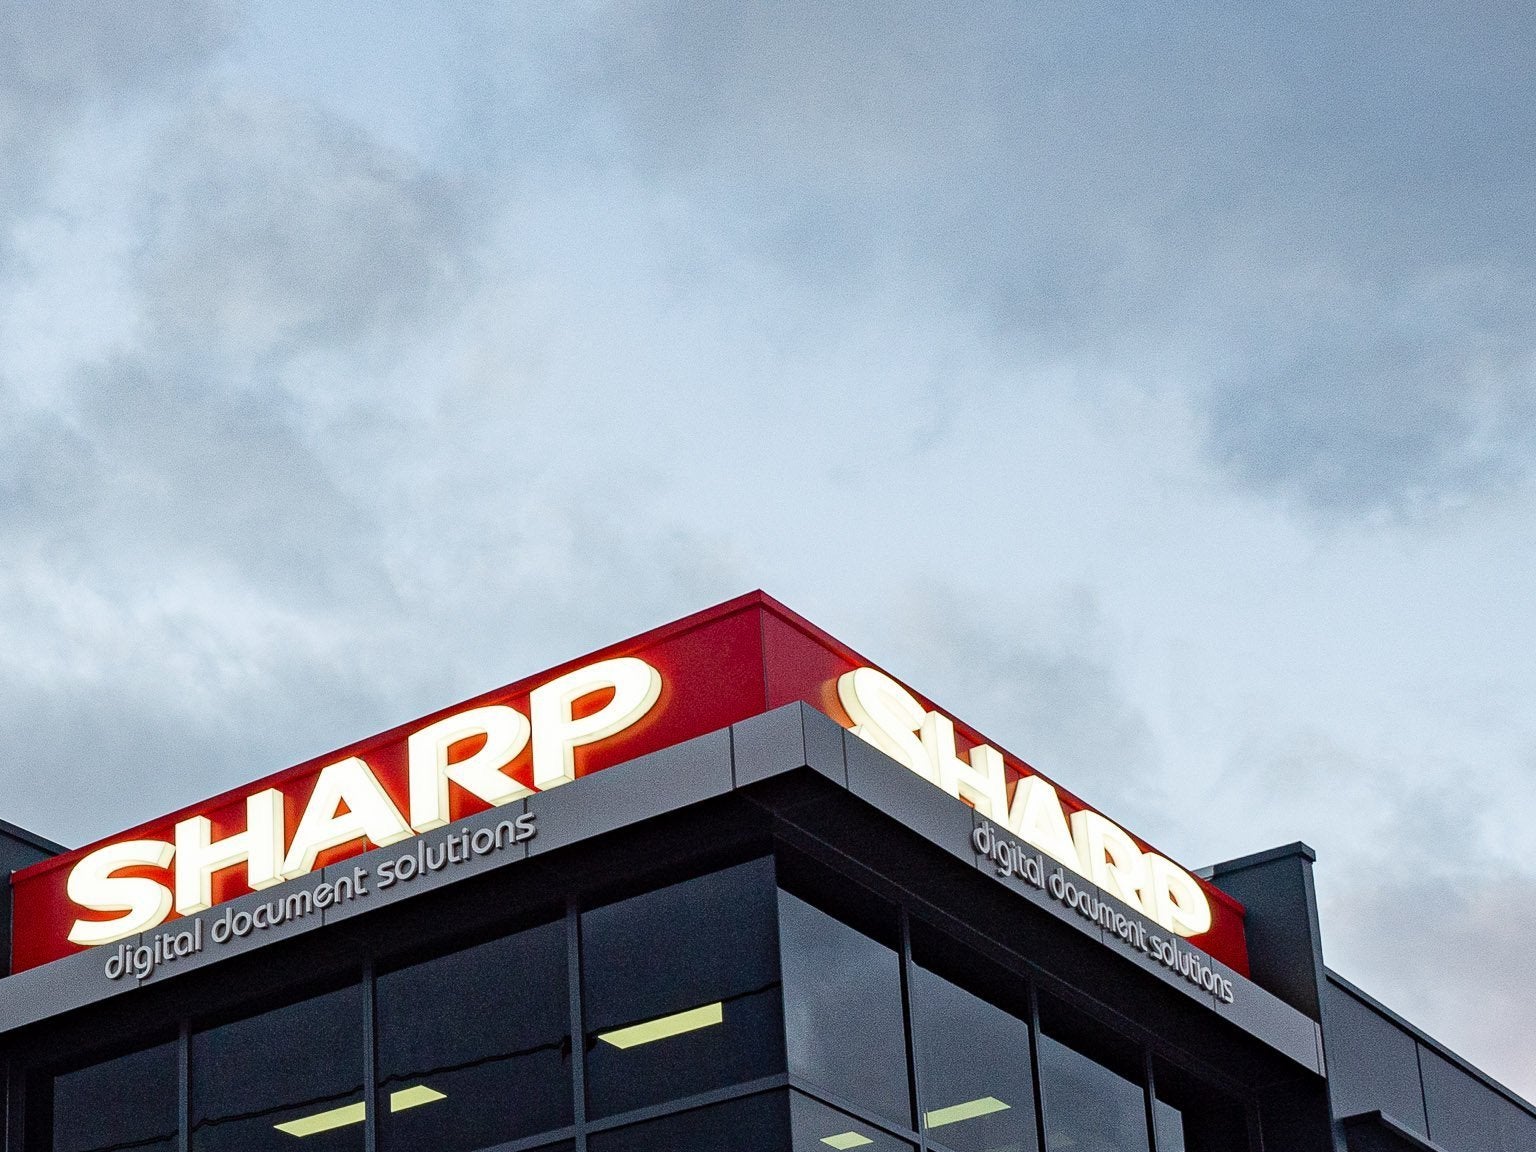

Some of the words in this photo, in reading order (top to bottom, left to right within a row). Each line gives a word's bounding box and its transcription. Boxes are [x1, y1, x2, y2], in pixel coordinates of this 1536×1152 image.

[66, 656, 663, 946] SHARP
[104, 926, 204, 980] digital
[211, 866, 369, 944] document
[376, 811, 537, 881] solutions
[837, 666, 1213, 937] SHARP
[972, 820, 1045, 890] digital
[1048, 867, 1148, 951] document
[1149, 933, 1235, 1004] solutions
